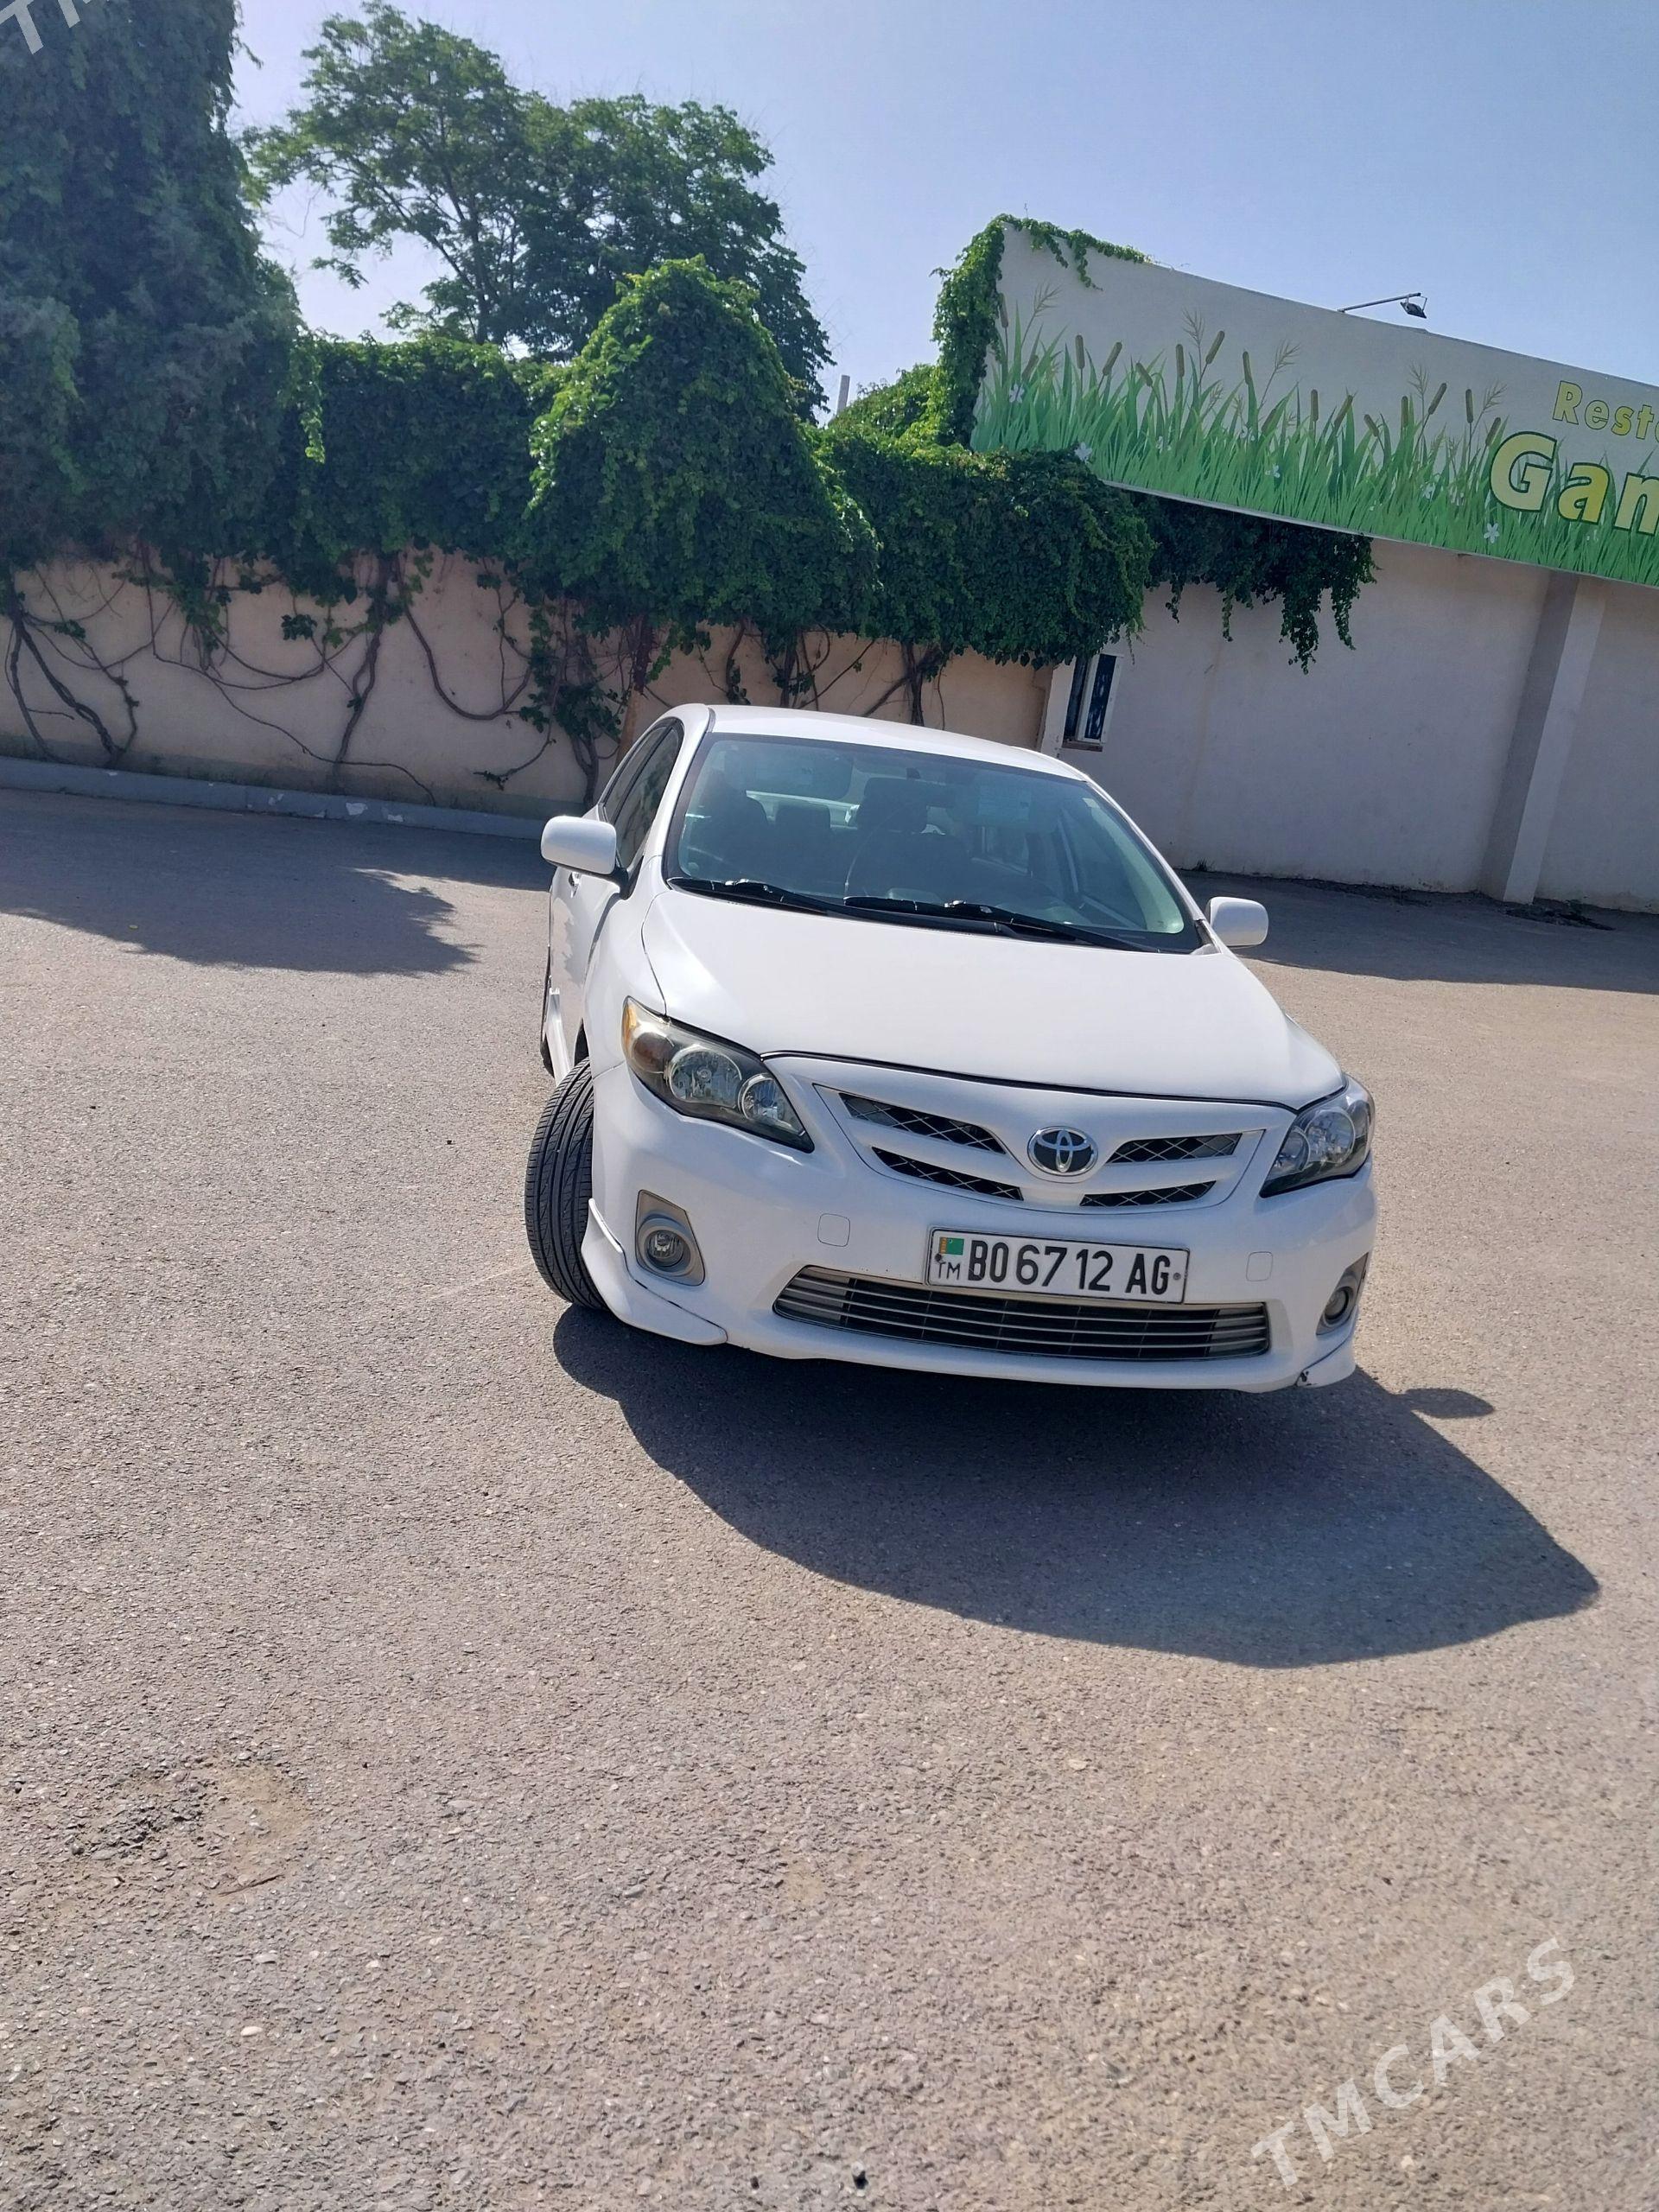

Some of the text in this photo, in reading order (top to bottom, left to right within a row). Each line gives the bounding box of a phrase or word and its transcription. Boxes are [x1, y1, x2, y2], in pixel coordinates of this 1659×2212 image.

[1553, 380, 1659, 444] Rest
[937, 1262, 961, 1281] TM
[1125, 1253, 1170, 1295] AG
